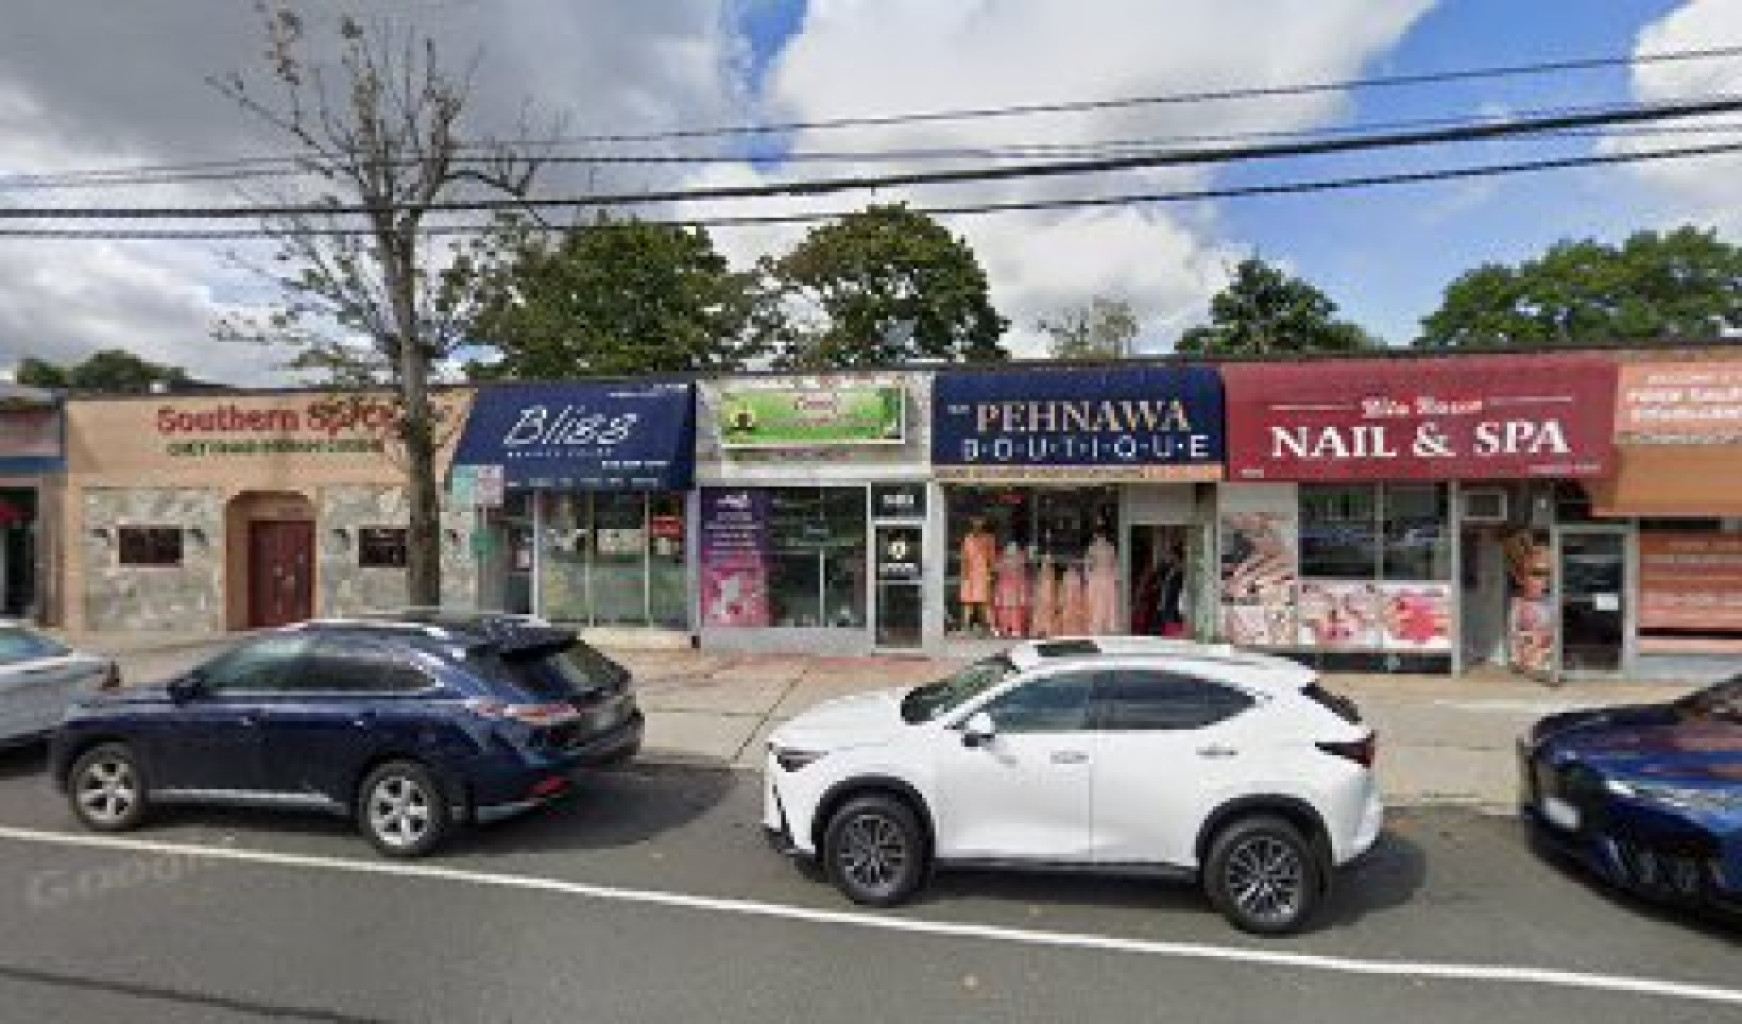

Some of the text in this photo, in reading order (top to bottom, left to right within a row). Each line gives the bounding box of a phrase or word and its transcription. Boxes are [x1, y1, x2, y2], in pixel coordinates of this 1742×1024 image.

[157, 405, 300, 435] Southern
[502, 403, 638, 446] Bliss
[976, 400, 1191, 432] PEHNAWA
[1270, 418, 1573, 458] NAIL & SPA
